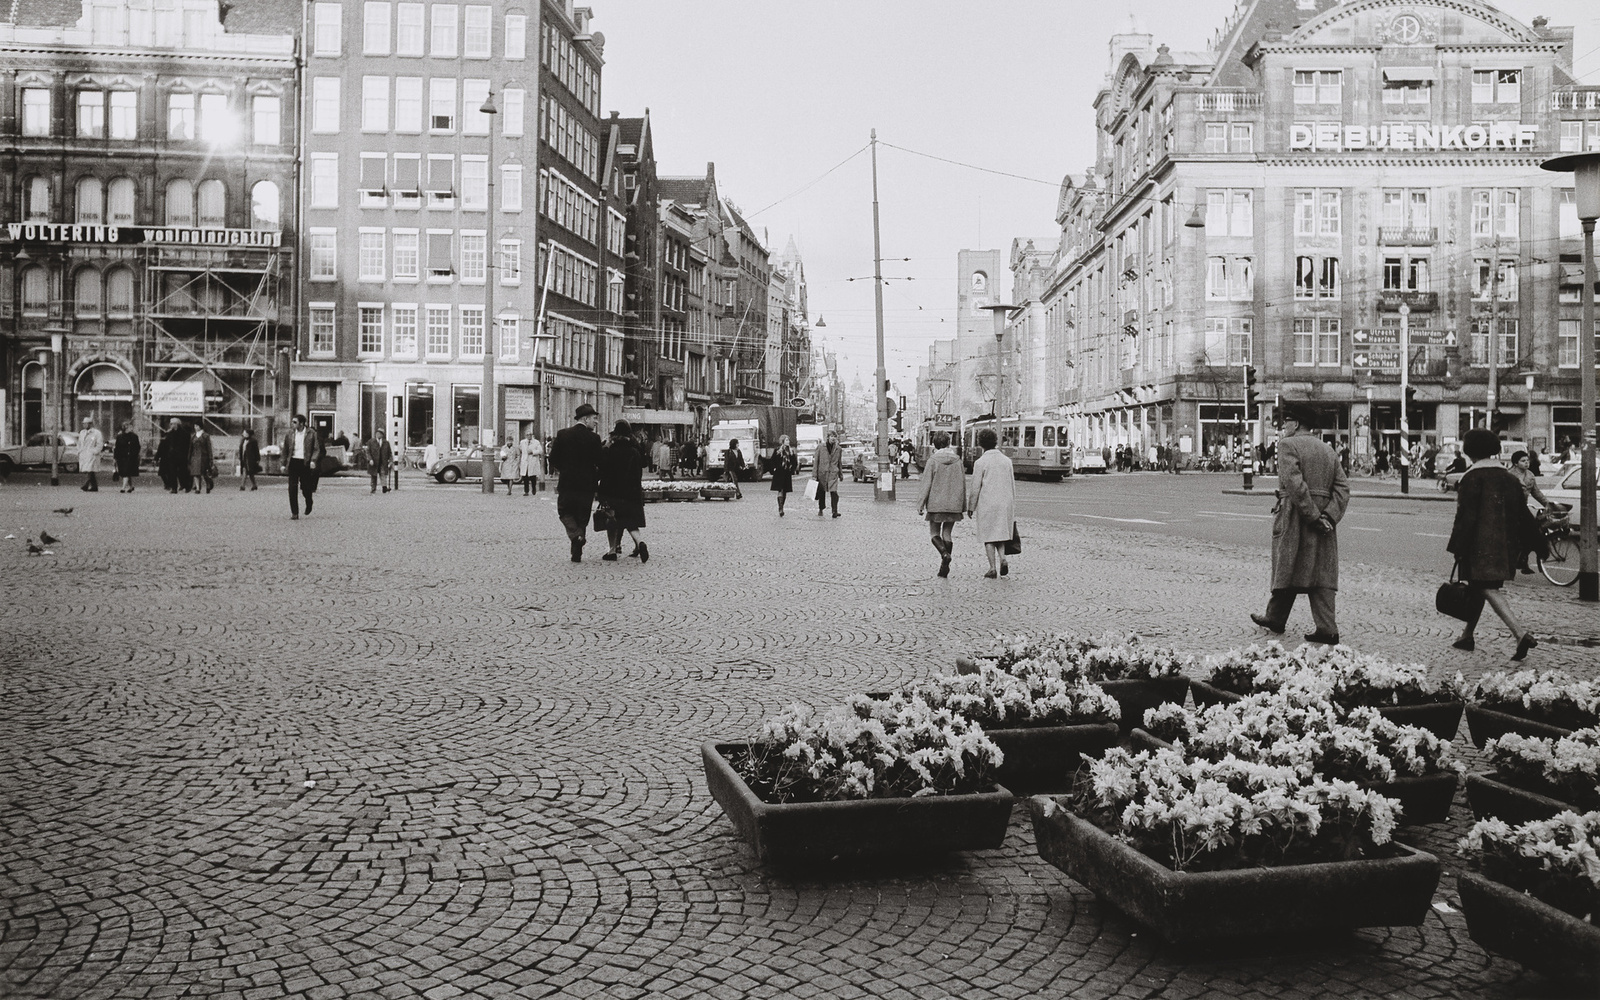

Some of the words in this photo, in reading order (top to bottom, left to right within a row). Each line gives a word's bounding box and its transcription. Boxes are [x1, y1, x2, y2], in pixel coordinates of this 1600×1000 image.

[1290, 125, 1342, 148] DE
[1344, 124, 1539, 148] BIJENKORF
[8, 223, 119, 242] WOLTERING
[143, 228, 282, 247] woninginrichting
[1369, 352, 1392, 360] Schiphol
[1382, 360, 1397, 368] Haag
[937, 414, 947, 422] 24
